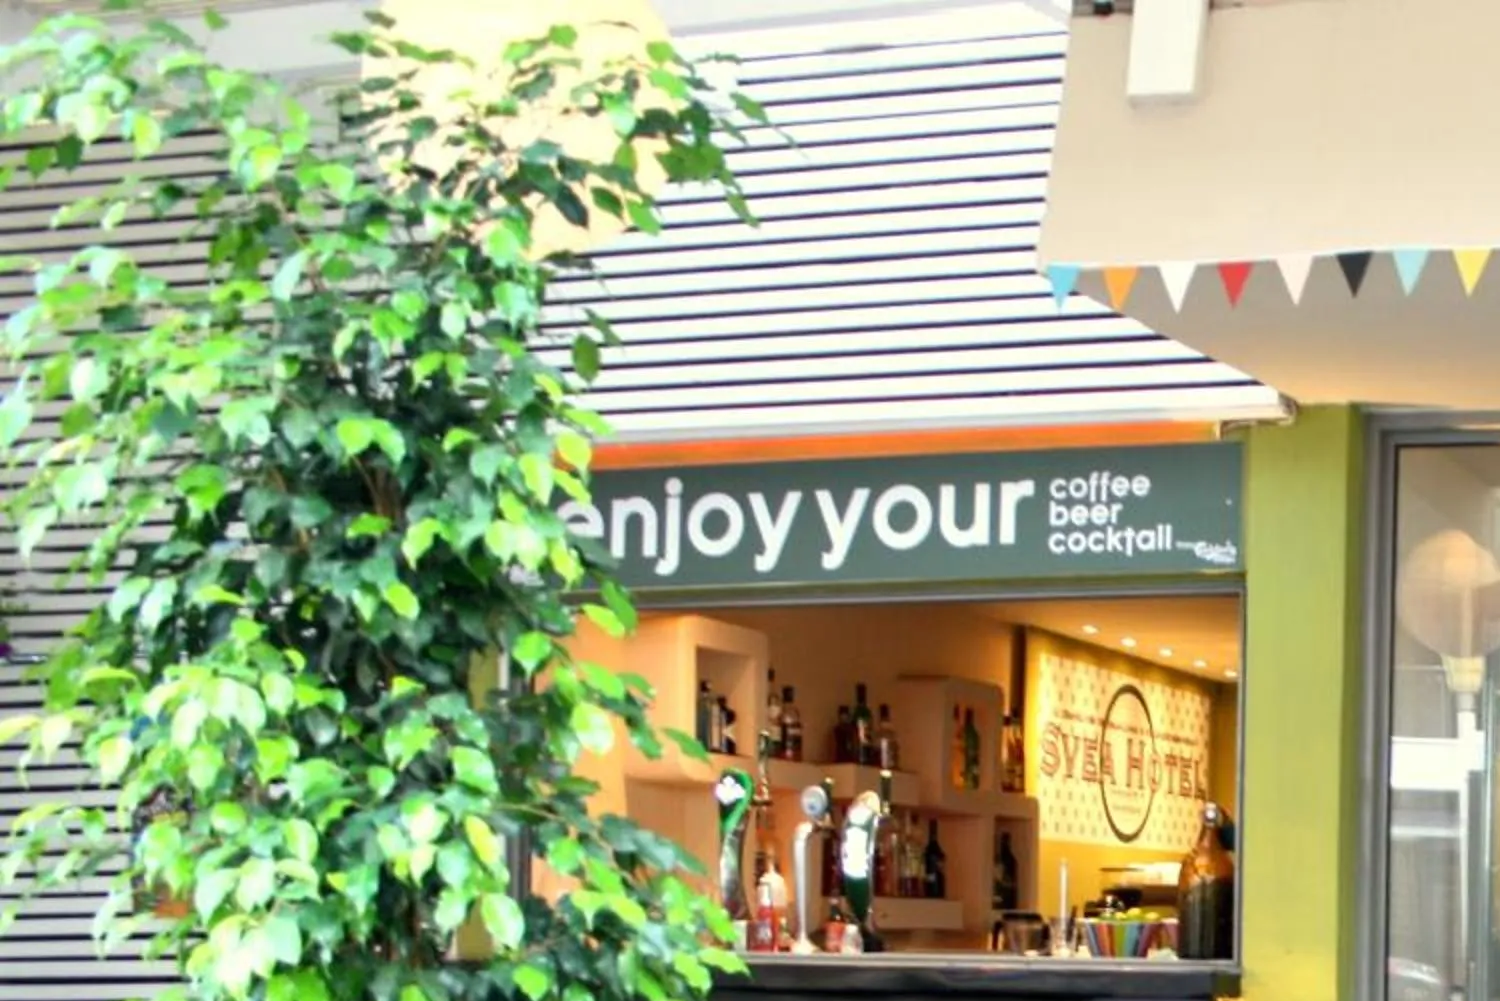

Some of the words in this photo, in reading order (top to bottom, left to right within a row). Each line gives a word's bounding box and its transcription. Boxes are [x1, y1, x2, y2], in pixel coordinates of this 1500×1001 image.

[1050, 471, 1150, 502] coffee
[557, 477, 801, 576] enjoy
[814, 479, 1034, 570] your
[1049, 500, 1123, 526] beer
[1040, 721, 1117, 786] SVEA
